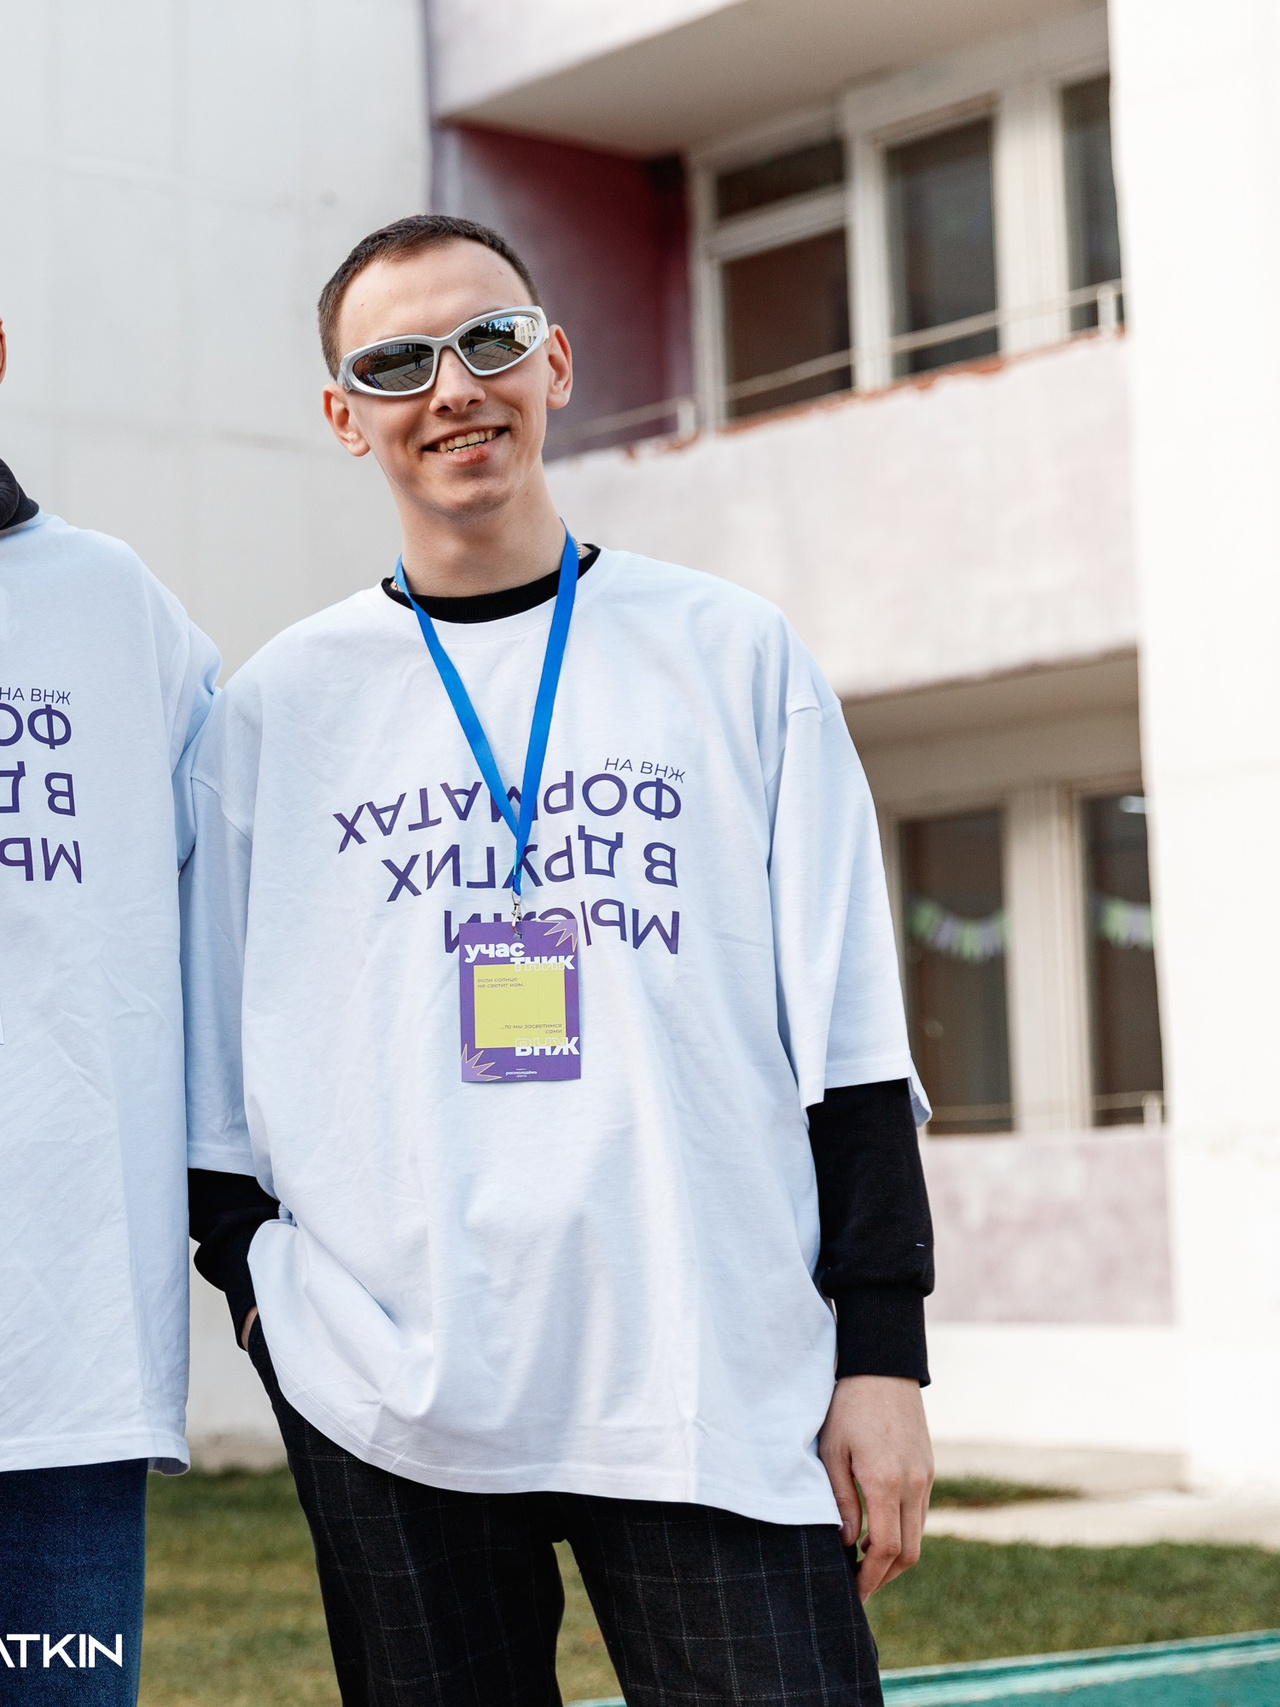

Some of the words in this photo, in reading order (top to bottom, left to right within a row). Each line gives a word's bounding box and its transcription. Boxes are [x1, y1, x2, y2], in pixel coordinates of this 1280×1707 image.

[30, 688, 71, 705] ВНЖ
[604, 758, 633, 772] НА
[640, 761, 686, 783] ВНЖ
[44, 772, 76, 817] В
[381, 825, 623, 902] ДРУГИХ
[643, 842, 678, 888] В
[464, 943, 525, 963] учас
[510, 955, 575, 972] тник
[514, 1036, 580, 1057] ВНЖ
